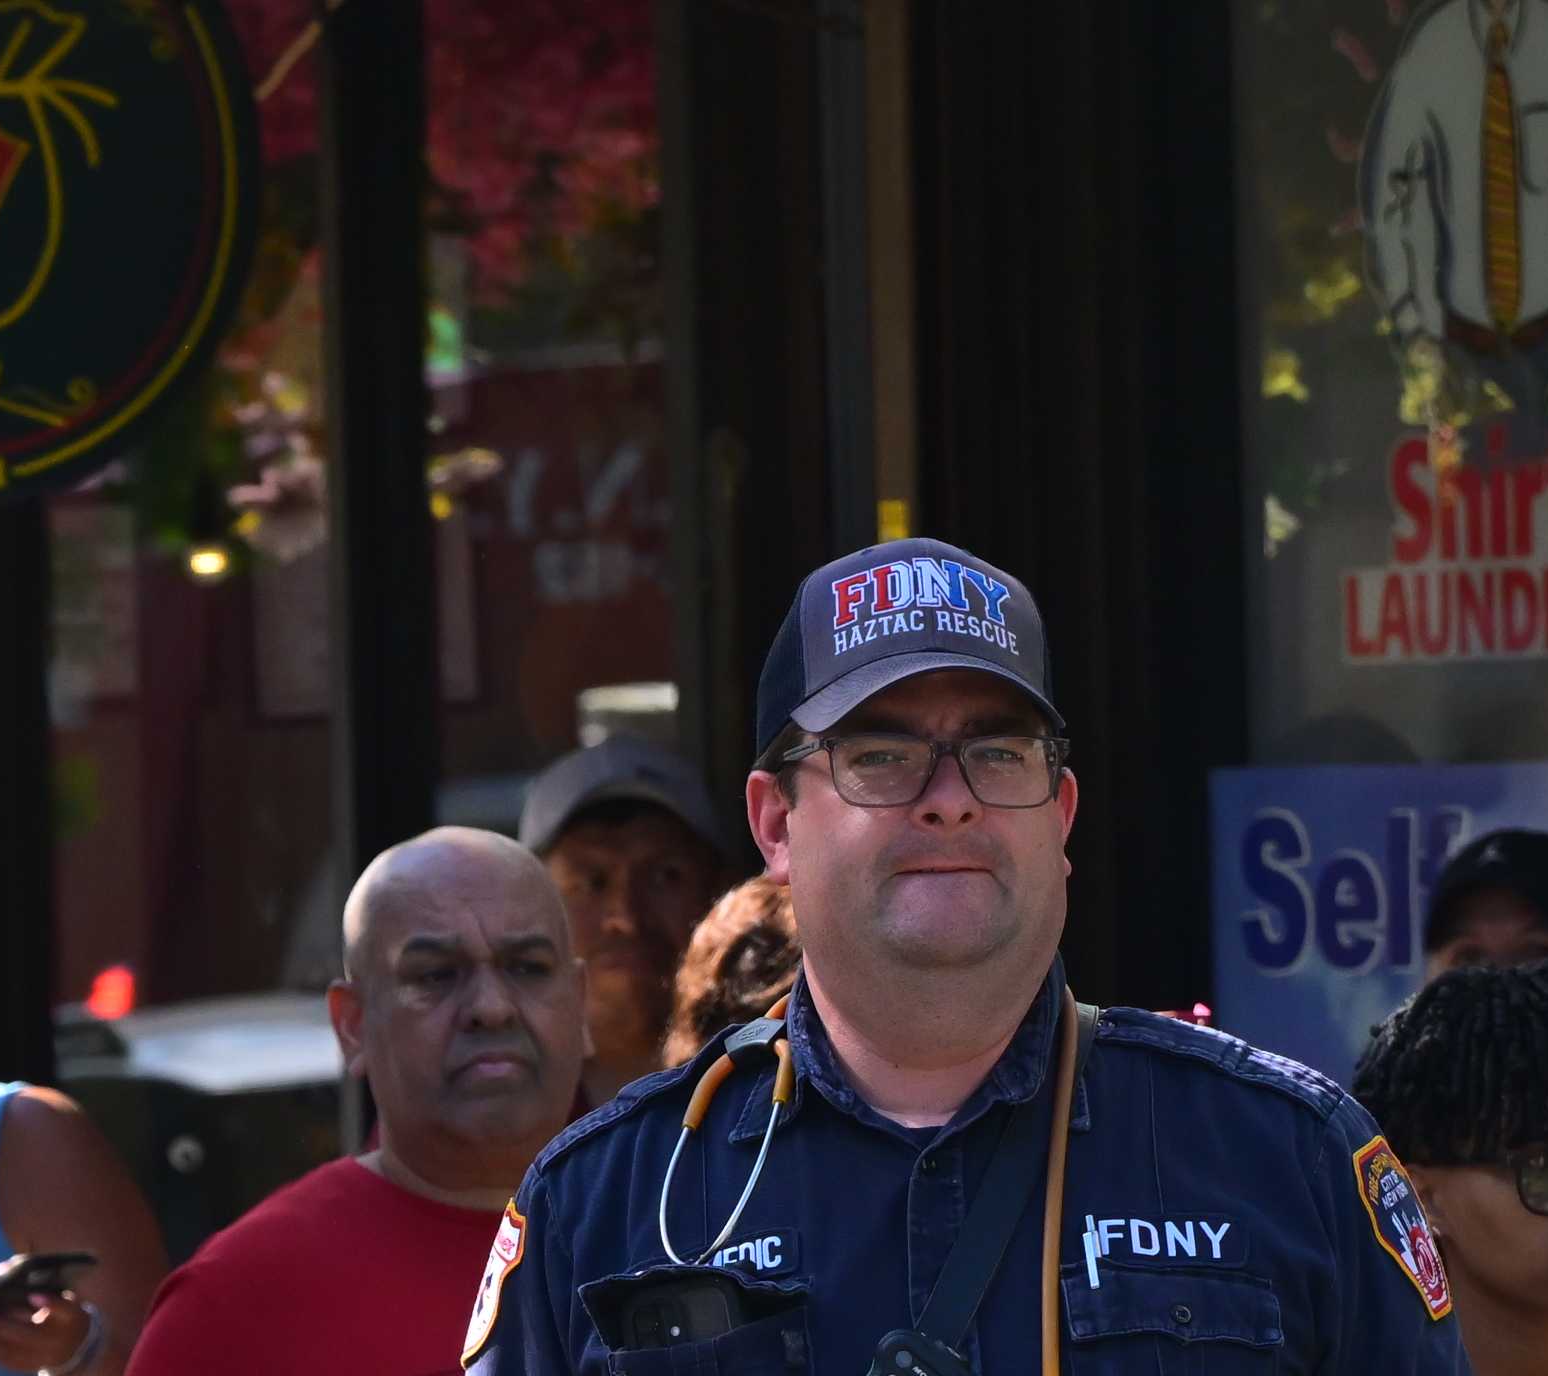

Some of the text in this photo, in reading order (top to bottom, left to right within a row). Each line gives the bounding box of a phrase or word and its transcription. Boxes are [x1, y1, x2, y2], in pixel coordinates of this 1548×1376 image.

[832, 557, 1010, 630] FDNY
[834, 611, 1020, 656] HAZTAC RESCUE
[1098, 1219, 1231, 1258] FDNY
